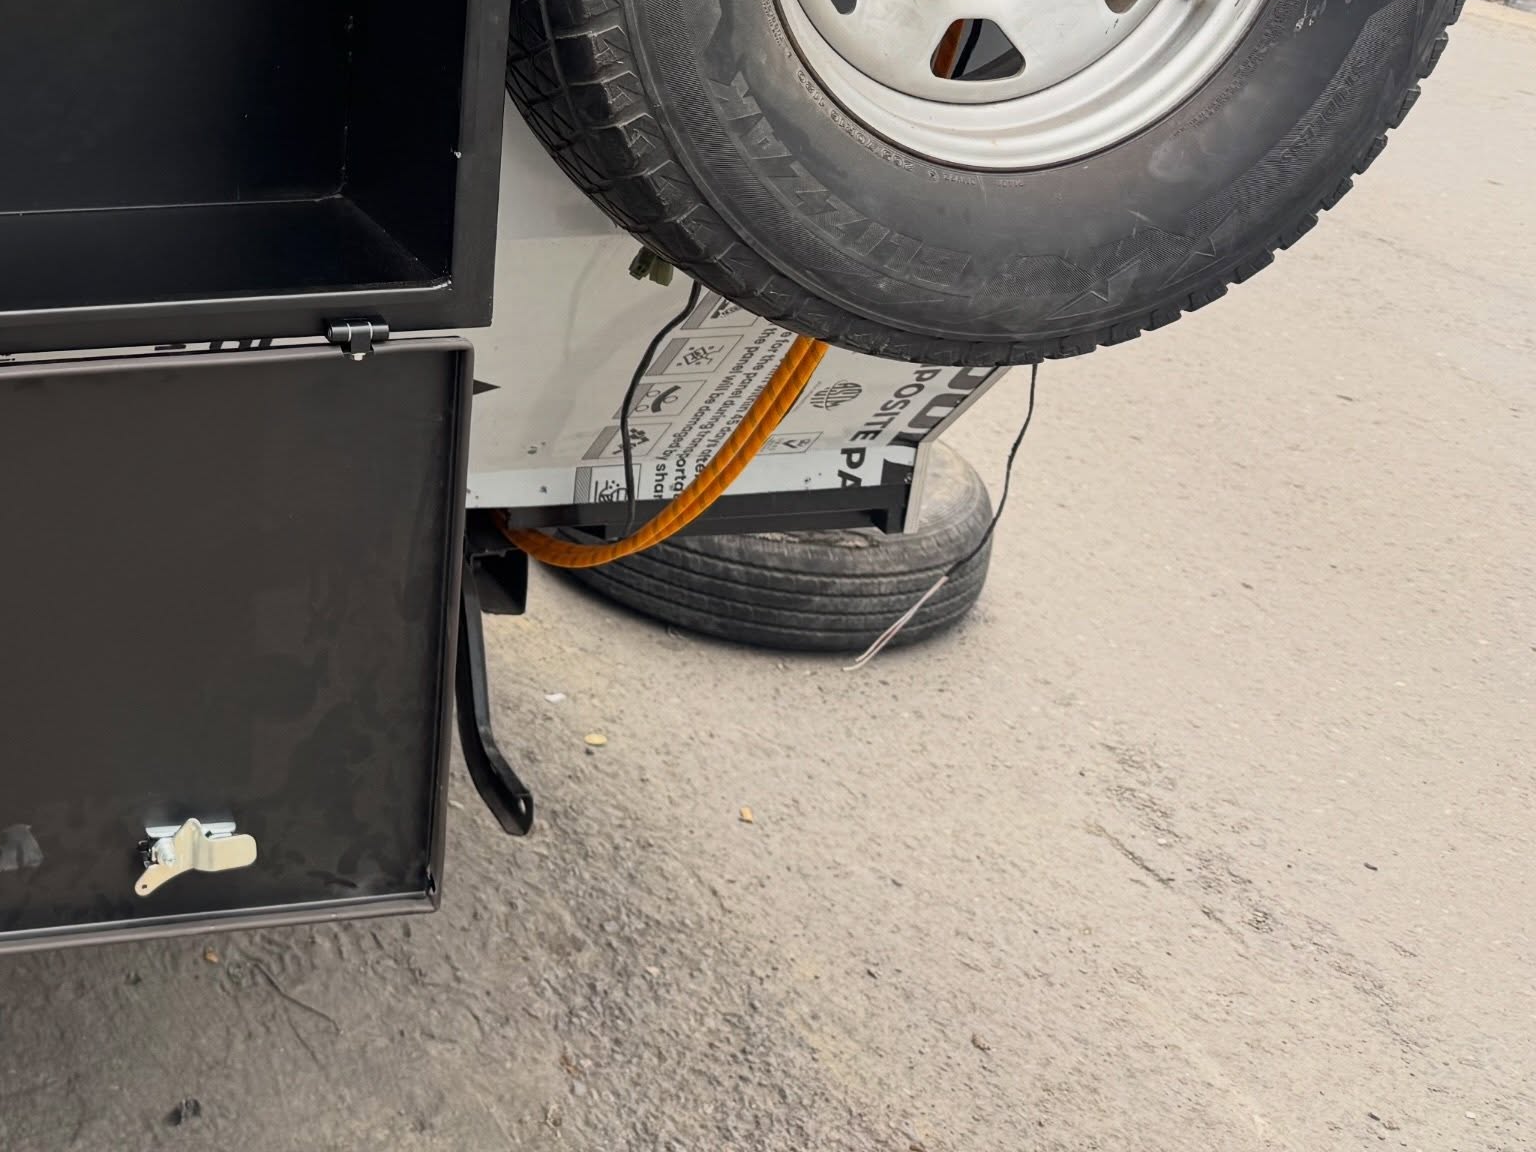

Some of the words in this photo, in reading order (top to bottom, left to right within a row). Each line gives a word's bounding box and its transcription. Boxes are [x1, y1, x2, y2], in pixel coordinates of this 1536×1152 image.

[706, 70, 973, 289] BLIZZAK
[753, 328, 778, 345] the
[767, 339, 790, 353] for
[729, 346, 761, 374] panel
[752, 354, 775, 371] the
[714, 374, 737, 392] will
[728, 372, 758, 399] panel
[704, 392, 725, 405] be
[849, 363, 942, 443] POSITE
[667, 405, 711, 449] damaged
[699, 399, 736, 430] during
[695, 449, 713, 477] afte
